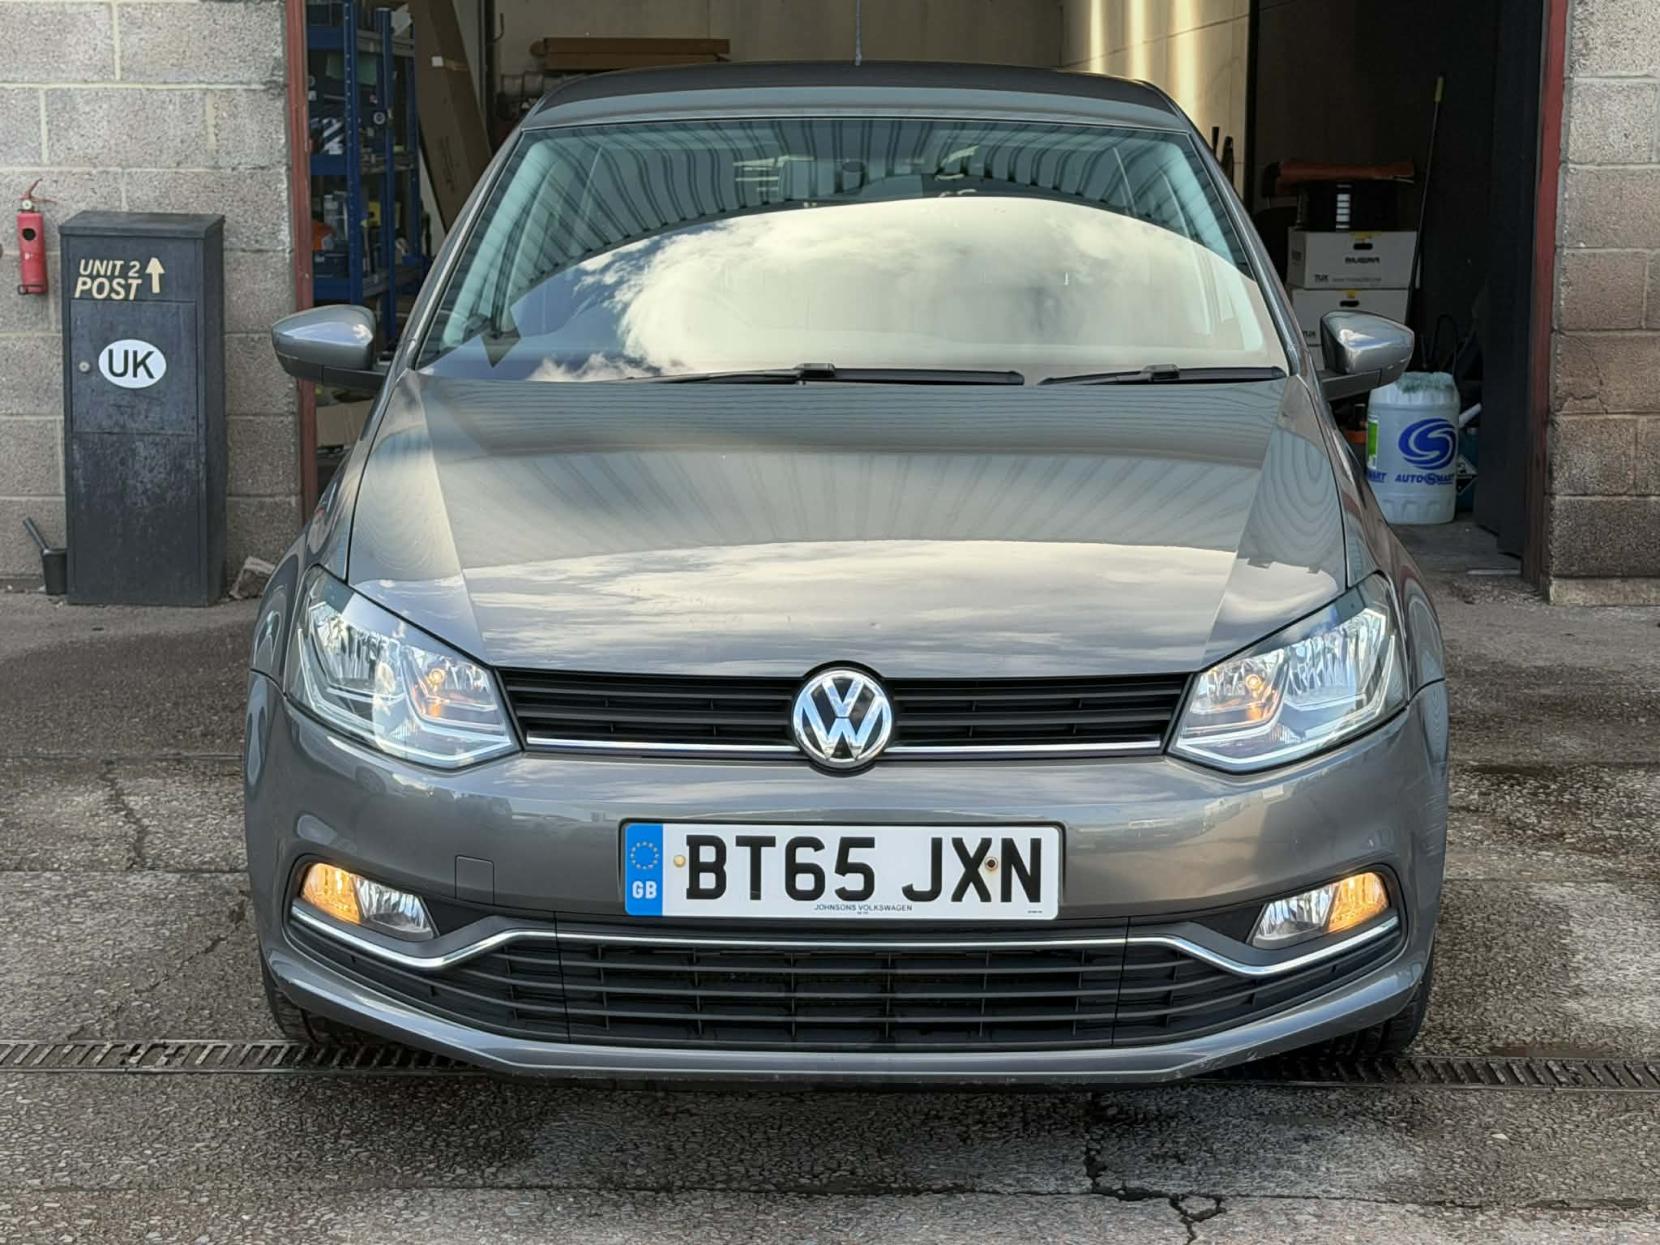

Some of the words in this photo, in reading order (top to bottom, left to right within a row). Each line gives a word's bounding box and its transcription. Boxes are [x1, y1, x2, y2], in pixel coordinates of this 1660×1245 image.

[79, 259, 124, 276] UNIT
[128, 260, 141, 278] 2
[74, 277, 143, 300] POST
[107, 348, 155, 379] UK
[686, 834, 875, 901] BT65
[901, 836, 1042, 903] JXN
[632, 881, 657, 899] GB
[814, 903, 857, 911] JOHNSONS
[858, 904, 913, 912] VOLKSWAGEN
